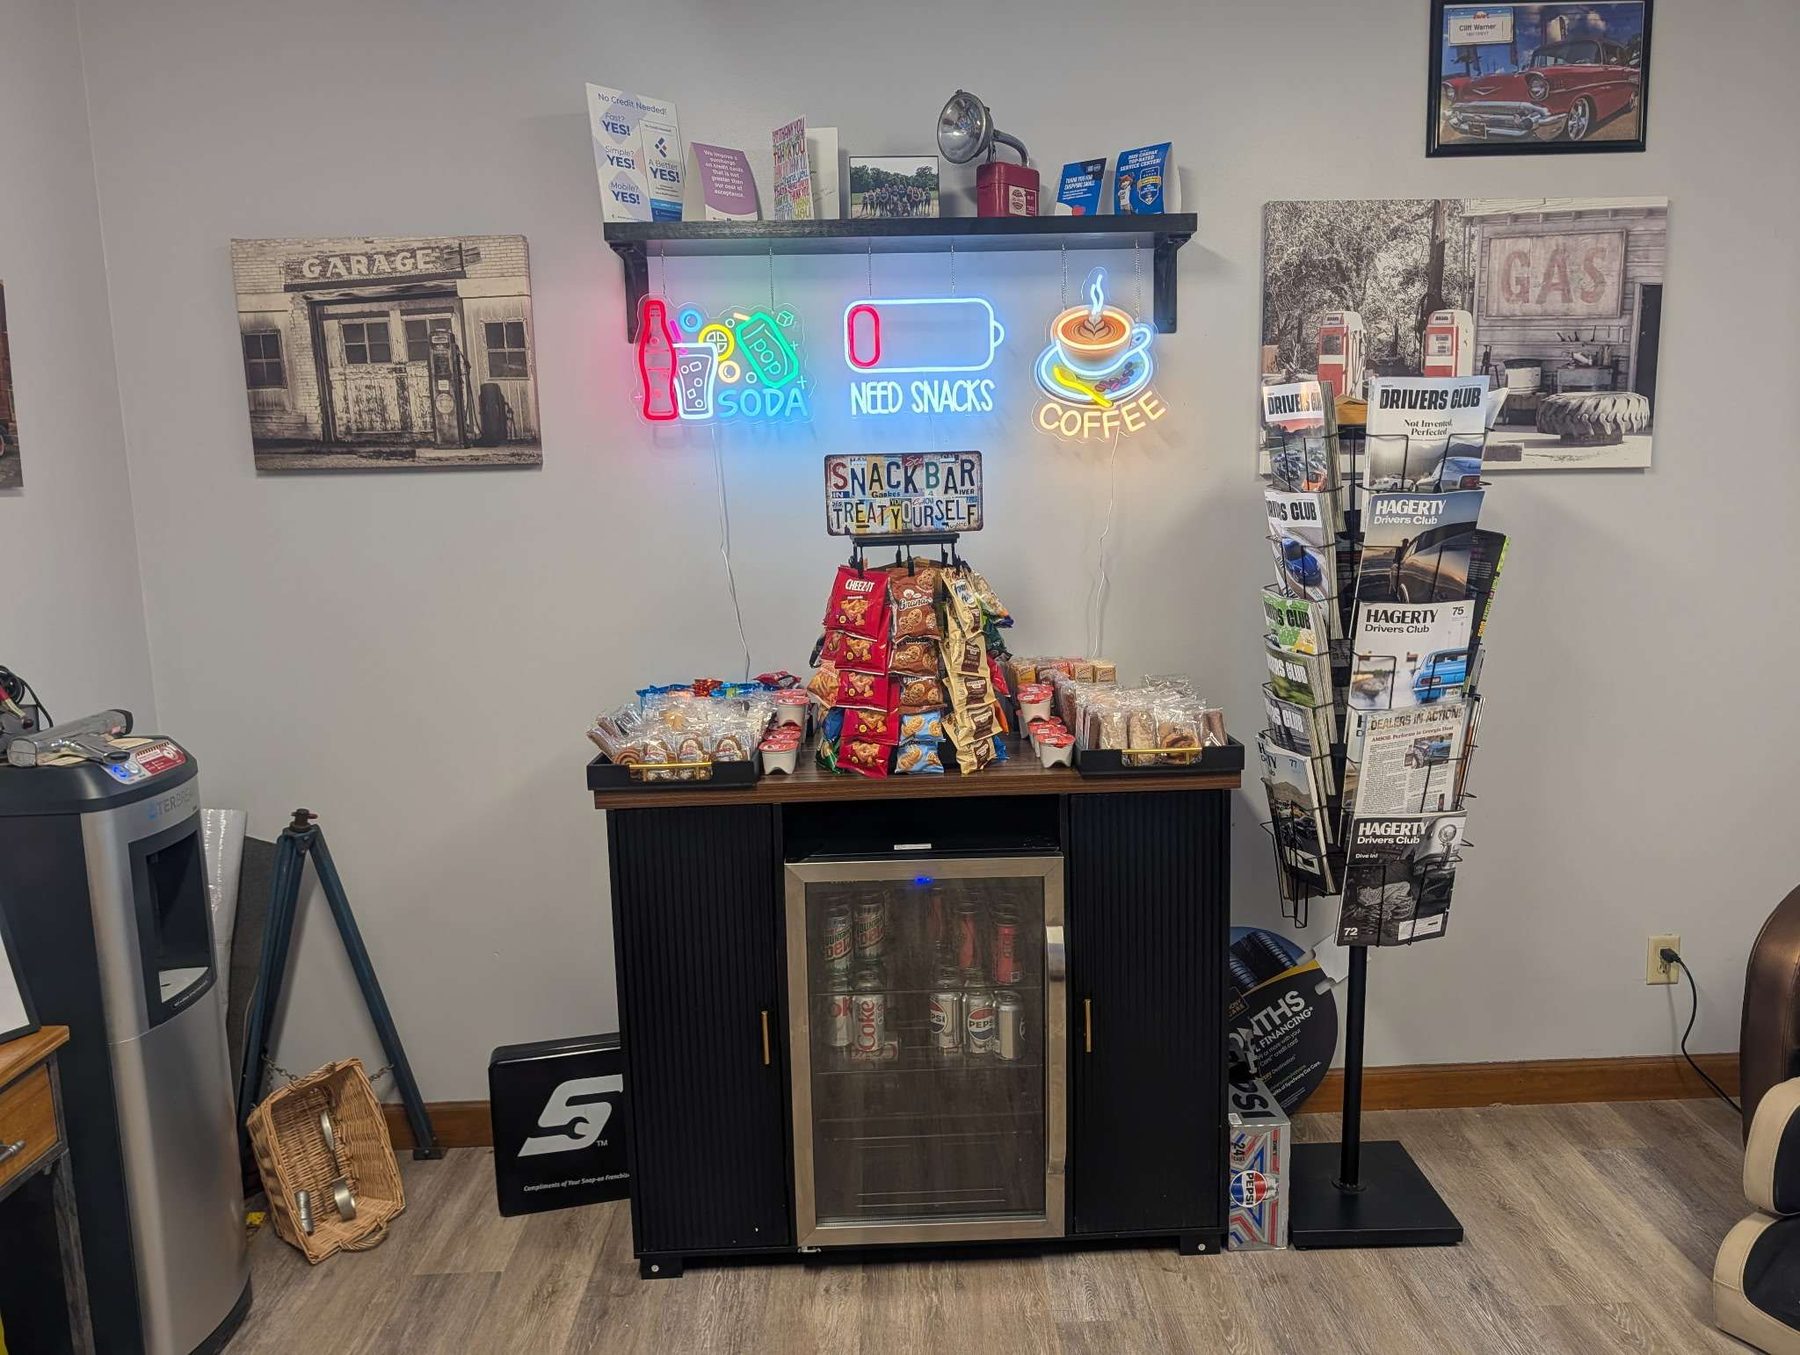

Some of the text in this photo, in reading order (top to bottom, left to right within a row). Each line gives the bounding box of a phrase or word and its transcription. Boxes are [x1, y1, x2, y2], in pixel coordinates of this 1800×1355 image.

[598, 93, 609, 103] No
[611, 96, 635, 108] Credit
[602, 120, 631, 136] YES!
[604, 145, 634, 157] Simple?
[607, 154, 636, 170] YES!
[650, 167, 680, 183] YES!
[611, 181, 639, 192] Mobile?
[611, 190, 640, 205] YES!
[302, 249, 441, 278] GARAGE
[1501, 247, 1608, 305] GAS
[750, 338, 782, 376] pop
[717, 388, 807, 418] SODA
[850, 378, 996, 415] NEED SNACKS
[1380, 387, 1481, 410] DRIVERS CLUB
[1039, 390, 1166, 438] COFFEE
[1404, 418, 1419, 427] Not
[831, 458, 976, 497] SNACK BAR
[832, 499, 976, 530] TREAT YOURSELF
[1290, 502, 1318, 521] CLUB
[1375, 499, 1447, 515] HAGERTY
[1374, 516, 1438, 525] Drivers Club
[1286, 608, 1311, 630] CLUB
[1366, 608, 1438, 624] HAGERTY
[1452, 606, 1464, 616] 75
[1364, 624, 1430, 634] Drivers Club
[1285, 661, 1308, 684] CLUB
[1282, 709, 1304, 732] CLUB
[1370, 714, 1412, 731] DEALERS
[1413, 713, 1425, 725] IN
[1426, 708, 1462, 723] ACTION!
[1358, 822, 1429, 836] HAGERTY
[1357, 836, 1420, 845] Drivers Club
[1343, 927, 1358, 936] 72
[597, 1140, 608, 1148] TM
[1232, 1142, 1246, 1159] 24
[524, 1181, 560, 1192] Compliments
[561, 1180, 567, 1188] of
[1245, 1172, 1255, 1206] PEPSI
